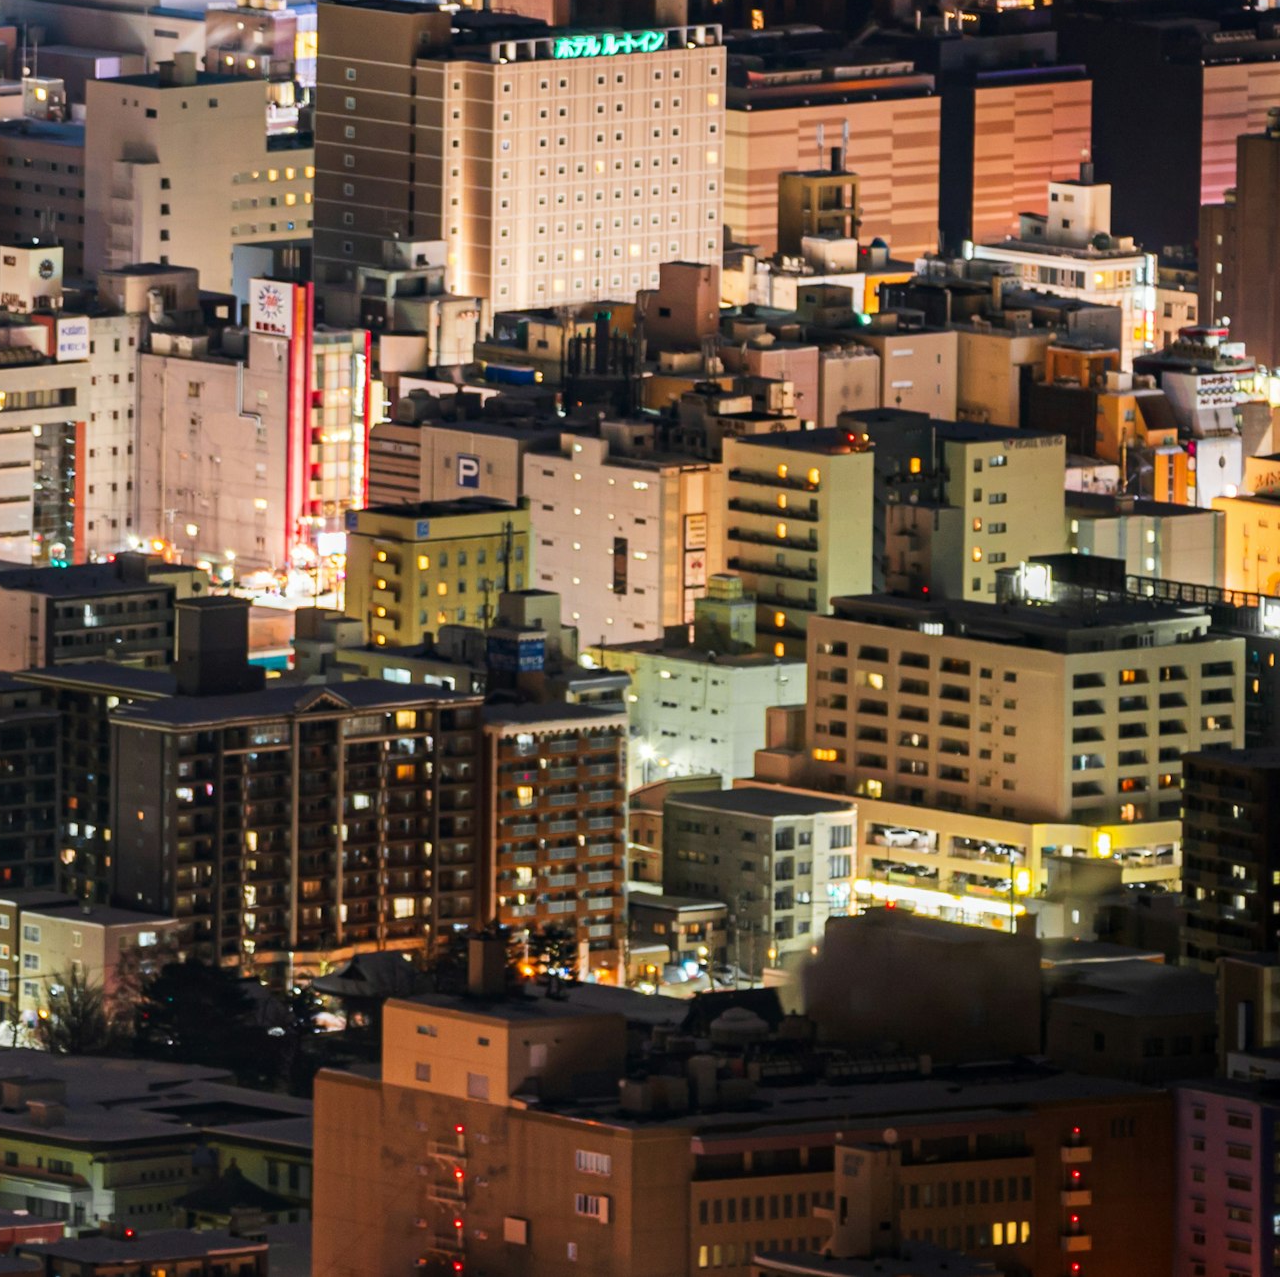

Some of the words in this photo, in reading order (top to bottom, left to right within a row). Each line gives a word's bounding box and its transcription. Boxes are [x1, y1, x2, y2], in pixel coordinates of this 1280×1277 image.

[554, 35, 601, 59] ホテル
[601, 30, 665, 56] ルートイン
[459, 458, 479, 485] P
